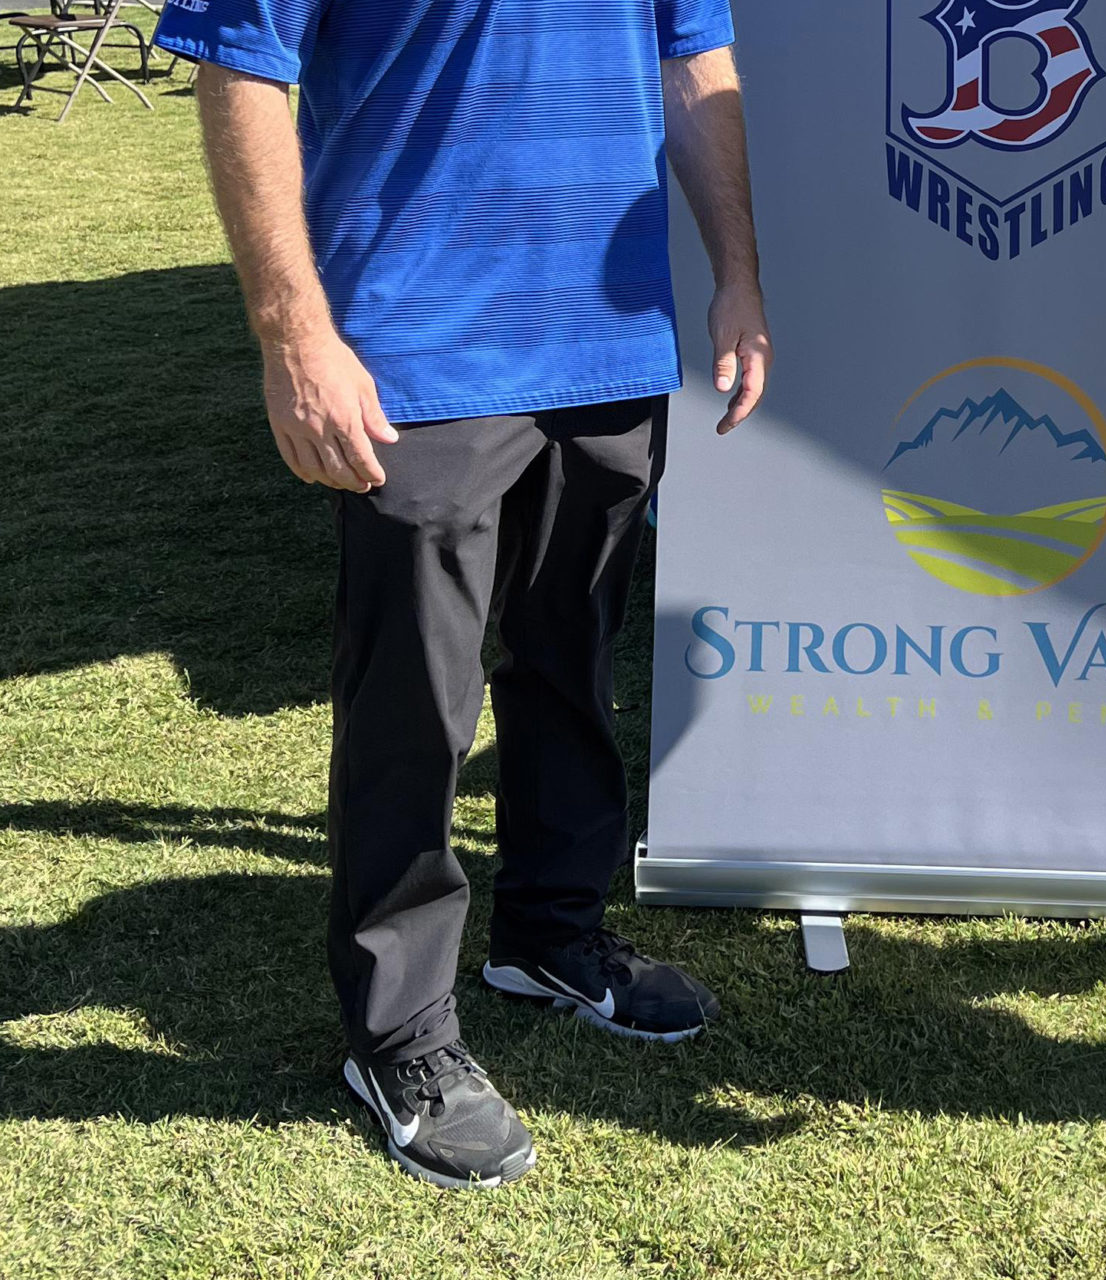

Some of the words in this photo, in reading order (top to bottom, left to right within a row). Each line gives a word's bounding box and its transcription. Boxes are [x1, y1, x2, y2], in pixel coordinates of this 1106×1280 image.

[684, 605, 1004, 681] STRONG
[747, 693, 937, 719] WEALTH
[977, 698, 993, 720] &
